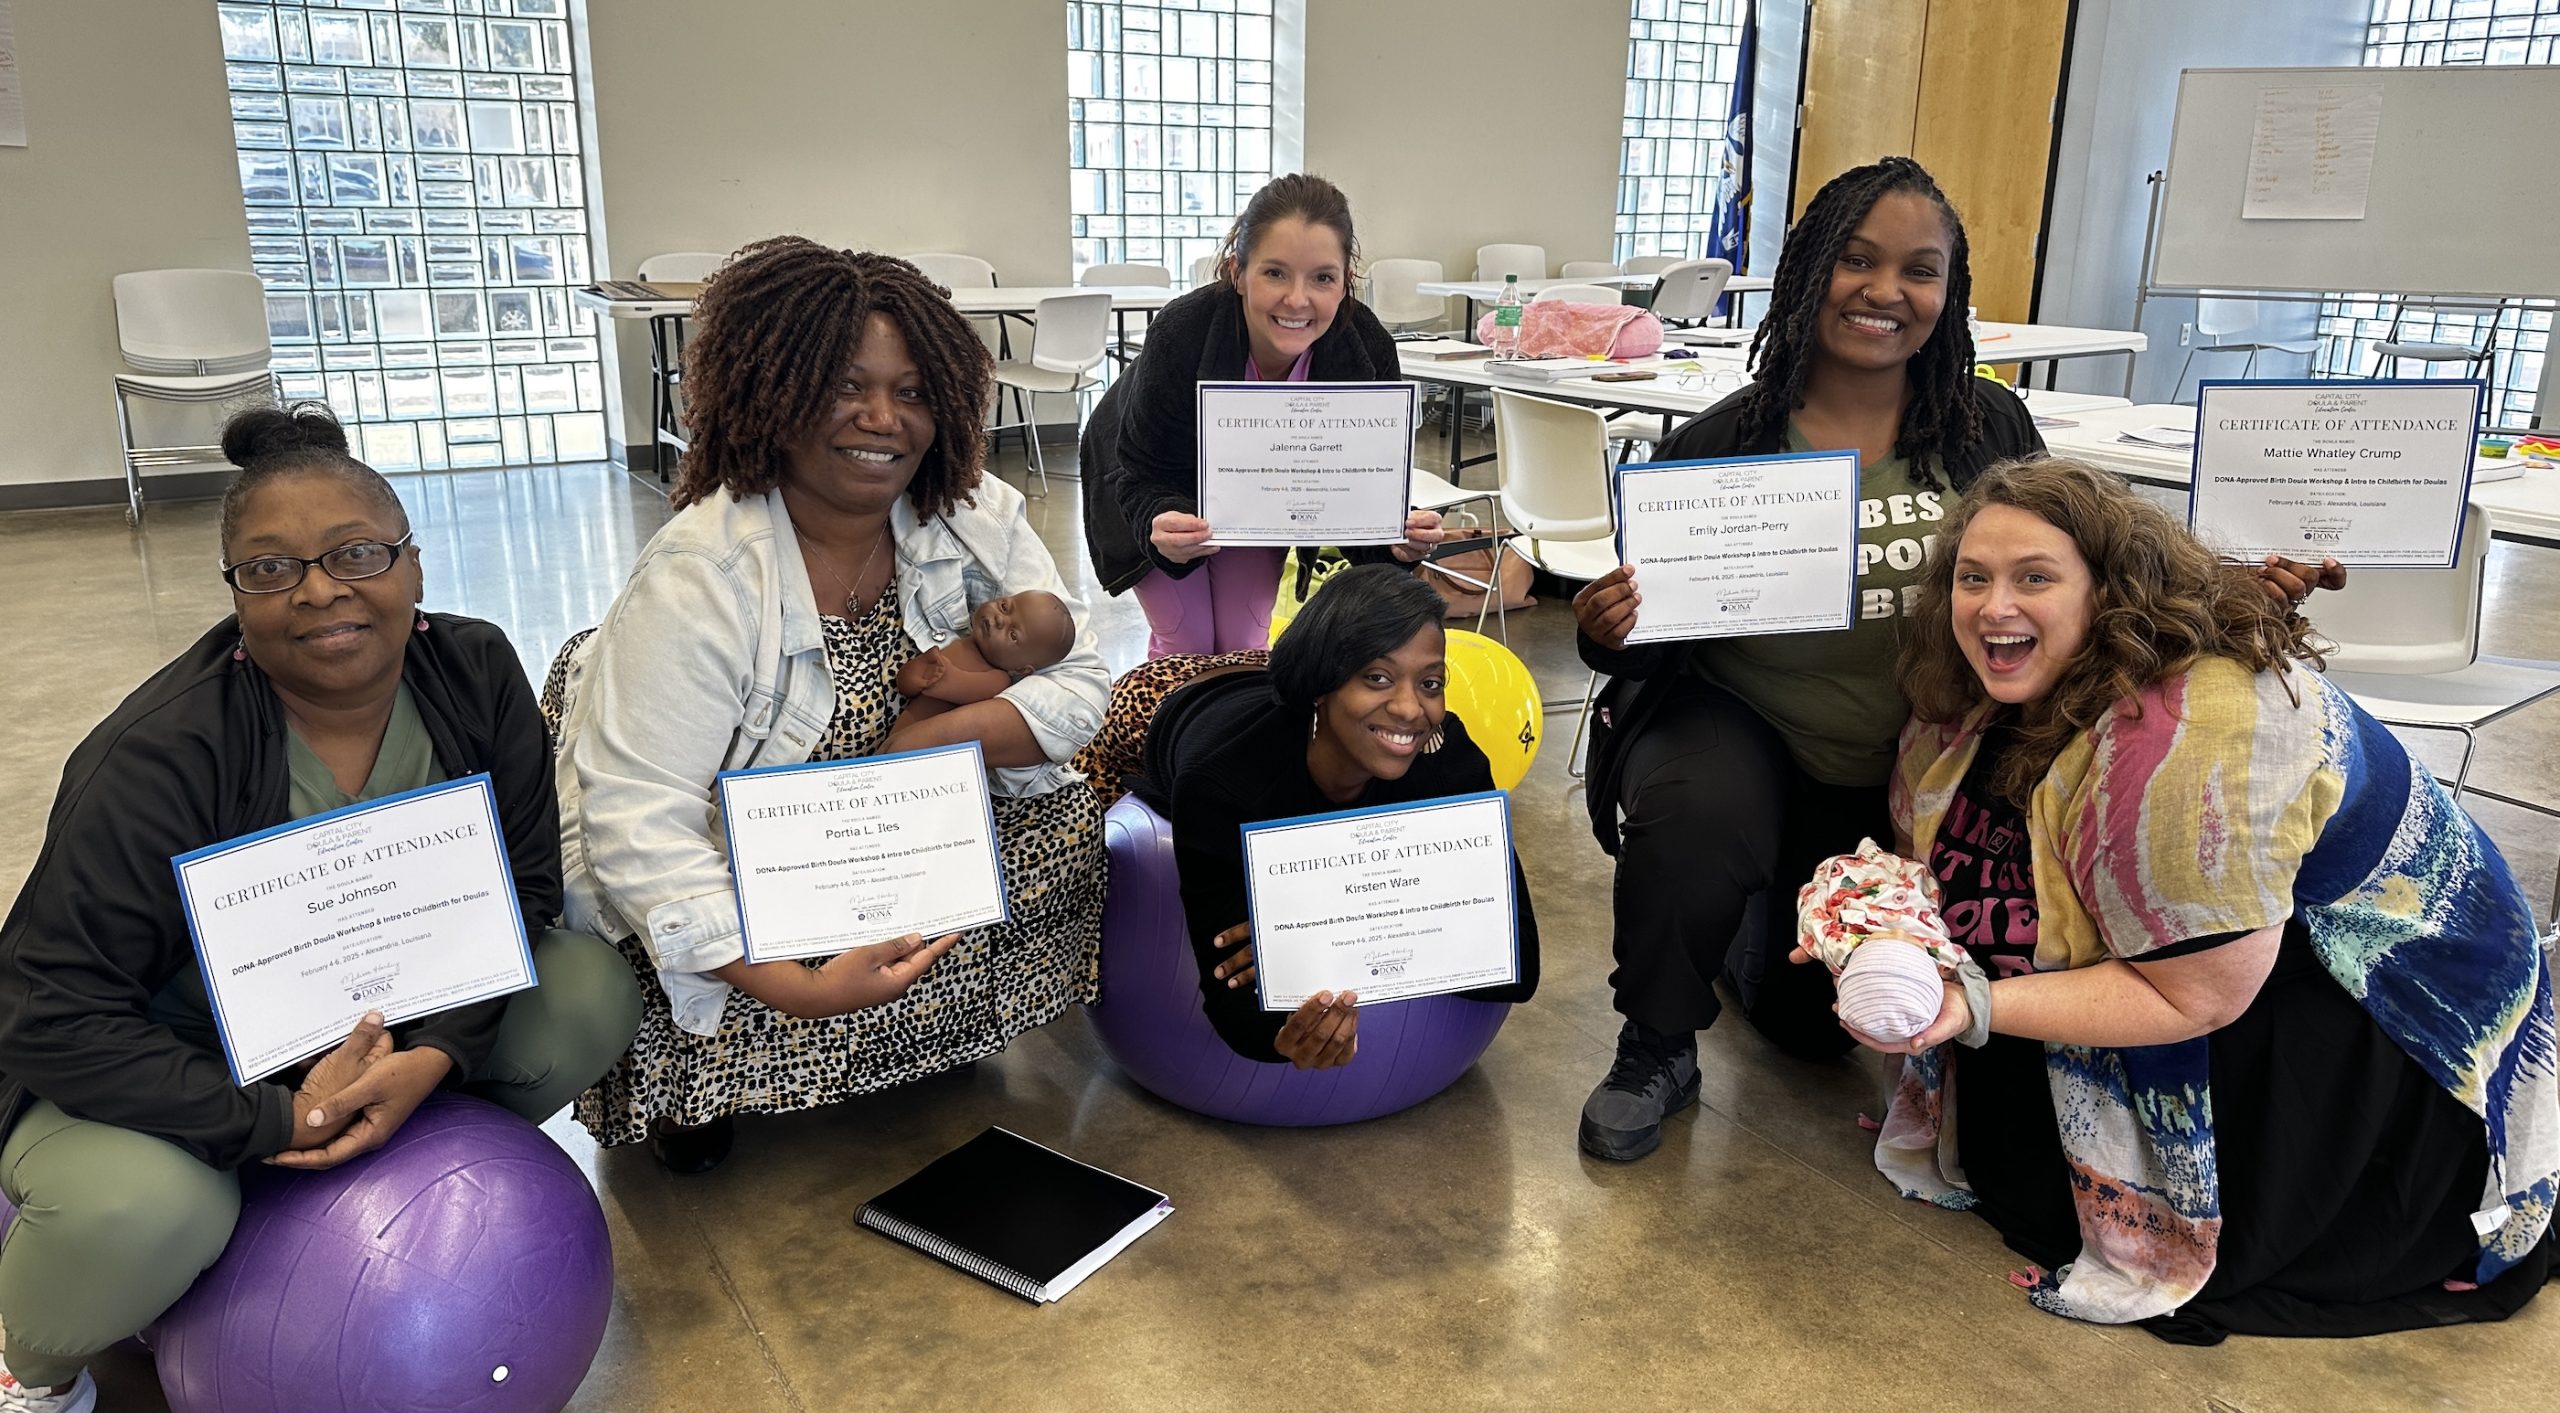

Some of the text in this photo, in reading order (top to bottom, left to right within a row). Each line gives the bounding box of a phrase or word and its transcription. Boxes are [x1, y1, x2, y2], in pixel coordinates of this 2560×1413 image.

[1217, 417, 1397, 429] CERTIFICATE OF ATTENDANCE
[2219, 419, 2458, 431] CERTIFICATE OF ATTENDANCE
[1269, 442, 1342, 452] Jalenna Garrett
[2263, 447, 2402, 460] Mattie Whatley Crump
[2214, 476, 2269, 484] DONA-Approved
[2308, 477, 2343, 486] Workshop
[1638, 489, 1841, 513] CERTIFICATE OF ATTENDANCE
[1689, 521, 1789, 536] Emily Jordan-Perry
[747, 782, 968, 820] CERTIFICATE OF ATTENDANCE
[825, 826, 861, 839] Portia
[877, 823, 900, 833] Iles
[1268, 852, 1366, 876] CERTIFICATE
[1370, 848, 1389, 862] OF
[1394, 835, 1492, 859] ATTENDANCE
[214, 823, 478, 910] CERTIFICATE OF ATTENDANCE
[1344, 877, 1420, 894] Kirsten Ware
[307, 880, 397, 914] Sue Johnson
[1273, 919, 1328, 931] DONA-Approved
[1328, 916, 1345, 925] Birth
[1345, 914, 1365, 922] Doula
[1365, 910, 1399, 919] Workshop
[1429, 900, 1461, 911] Childbirth
[1472, 896, 1495, 905] Doulas
[231, 947, 293, 976] DONA-Approved
[293, 941, 312, 953] Birth
[312, 933, 336, 946] Doula
[335, 921, 375, 937] Workshop
[382, 913, 402, 923] Intro
[412, 899, 450, 915] Childbirth
[450, 897, 461, 905] for
[462, 890, 489, 902] Doulas
[361, 982, 393, 998] DONA
